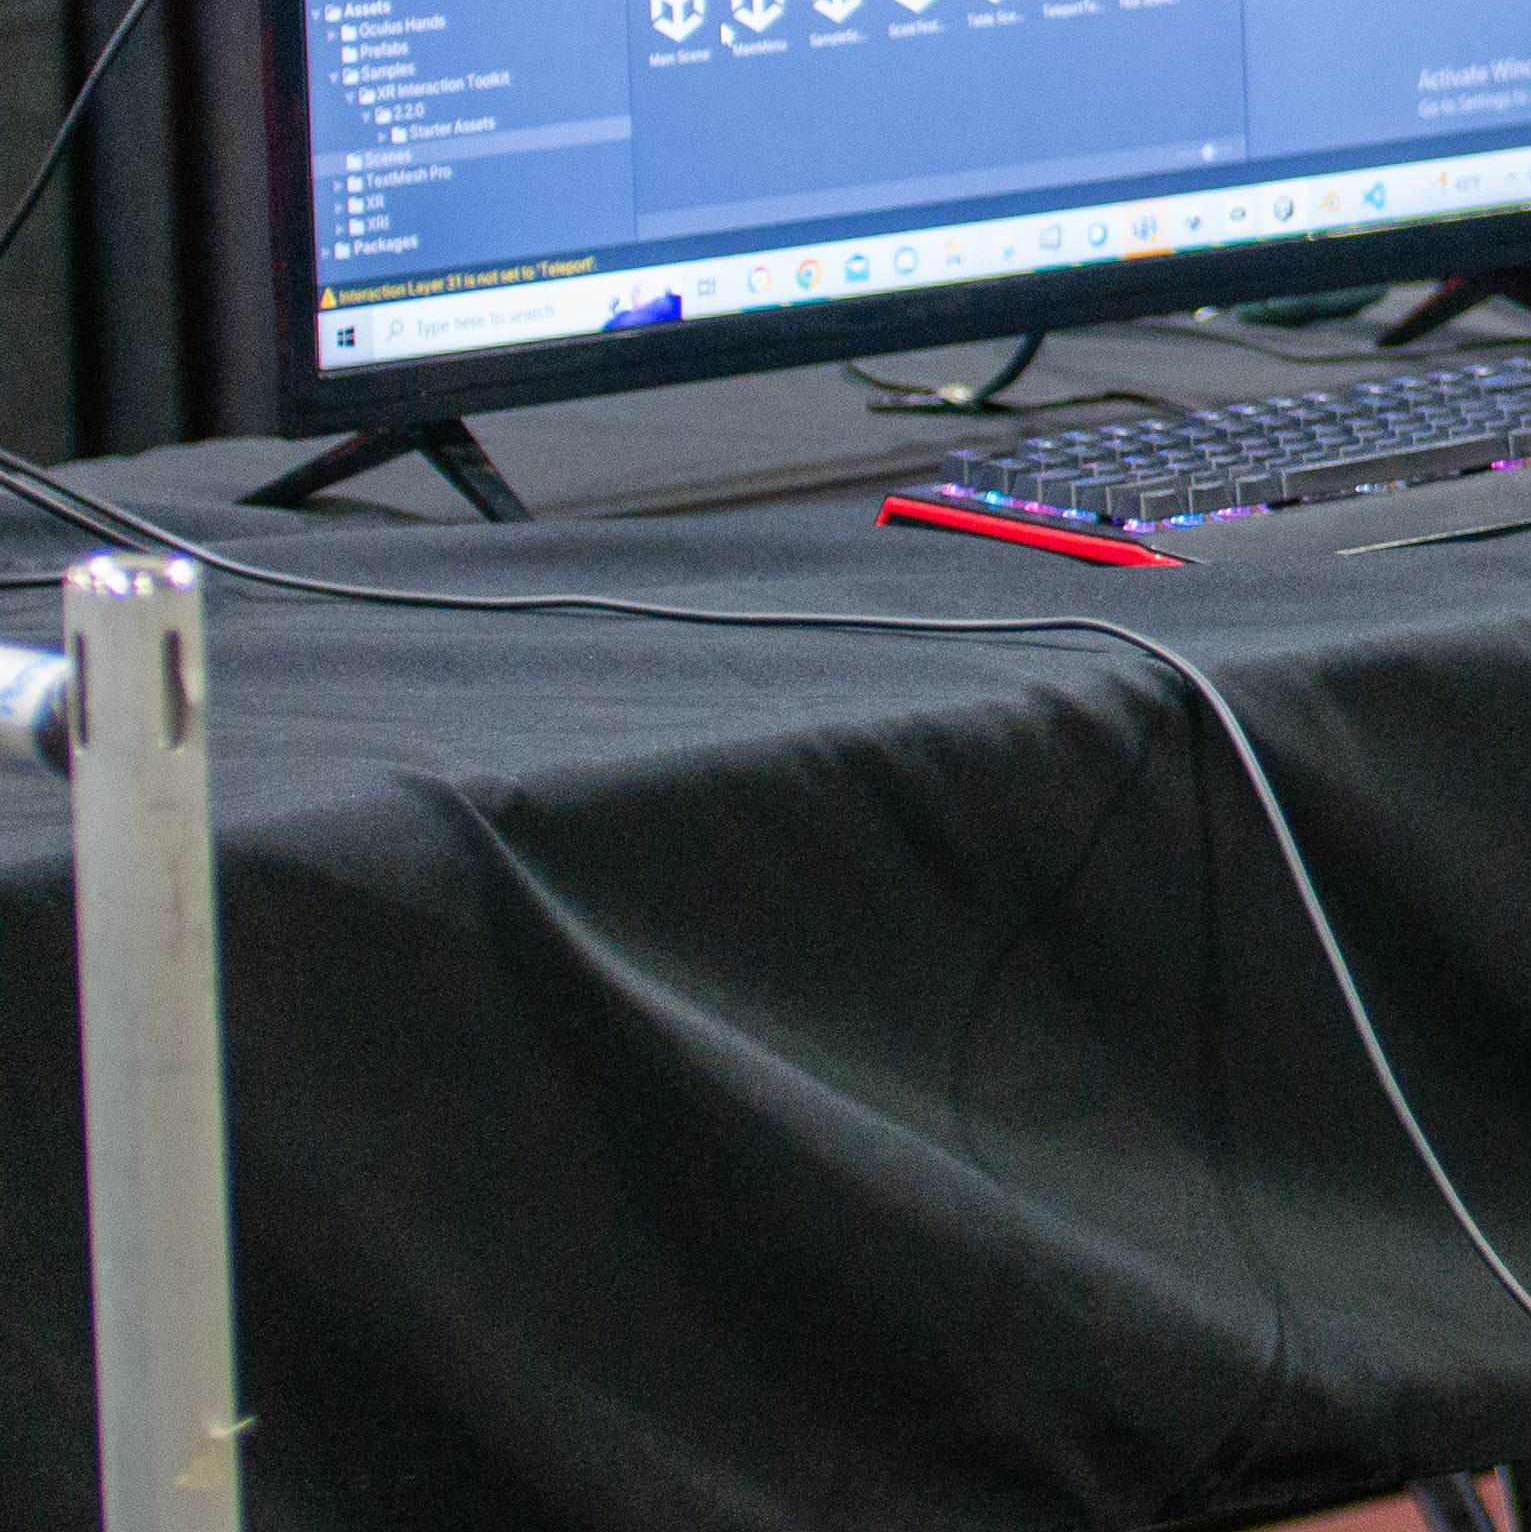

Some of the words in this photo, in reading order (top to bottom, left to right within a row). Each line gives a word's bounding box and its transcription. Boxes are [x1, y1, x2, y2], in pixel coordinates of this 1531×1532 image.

[344, 0, 392, 18] Assets
[358, 20, 401, 40] Oculus
[404, 14, 447, 33] Hands
[359, 41, 409, 60] Prefabs
[360, 62, 415, 83] Samples
[1417, 64, 1489, 91] Activate
[377, 84, 395, 100] XR
[397, 77, 464, 99] Interaction
[466, 70, 510, 90] Toolkit
[393, 102, 425, 120] 2.2.0
[1418, 98, 1440, 119] Go
[1441, 97, 1457, 115] to
[1459, 91, 1511, 114] Settings
[1513, 90, 1527, 105] to
[409, 121, 451, 141] Starter
[454, 117, 496, 134] Assets
[365, 149, 413, 167] Scenes
[366, 167, 428, 188] TextMesh
[429, 165, 452, 181] Pro
[366, 194, 385, 211] XR
[366, 214, 391, 231] XRI
[353, 234, 419, 256] Packages
[338, 285, 405, 304] Interaction
[407, 276, 444, 298] Layer
[447, 273, 462, 288] 31
[464, 272, 475, 287] is
[477, 268, 498, 285] not
[501, 267, 520, 282] set
[521, 265, 535, 280] to
[417, 318, 450, 336] Type
[454, 313, 486, 330] here
[490, 312, 504, 326] to
[509, 305, 554, 323] search
